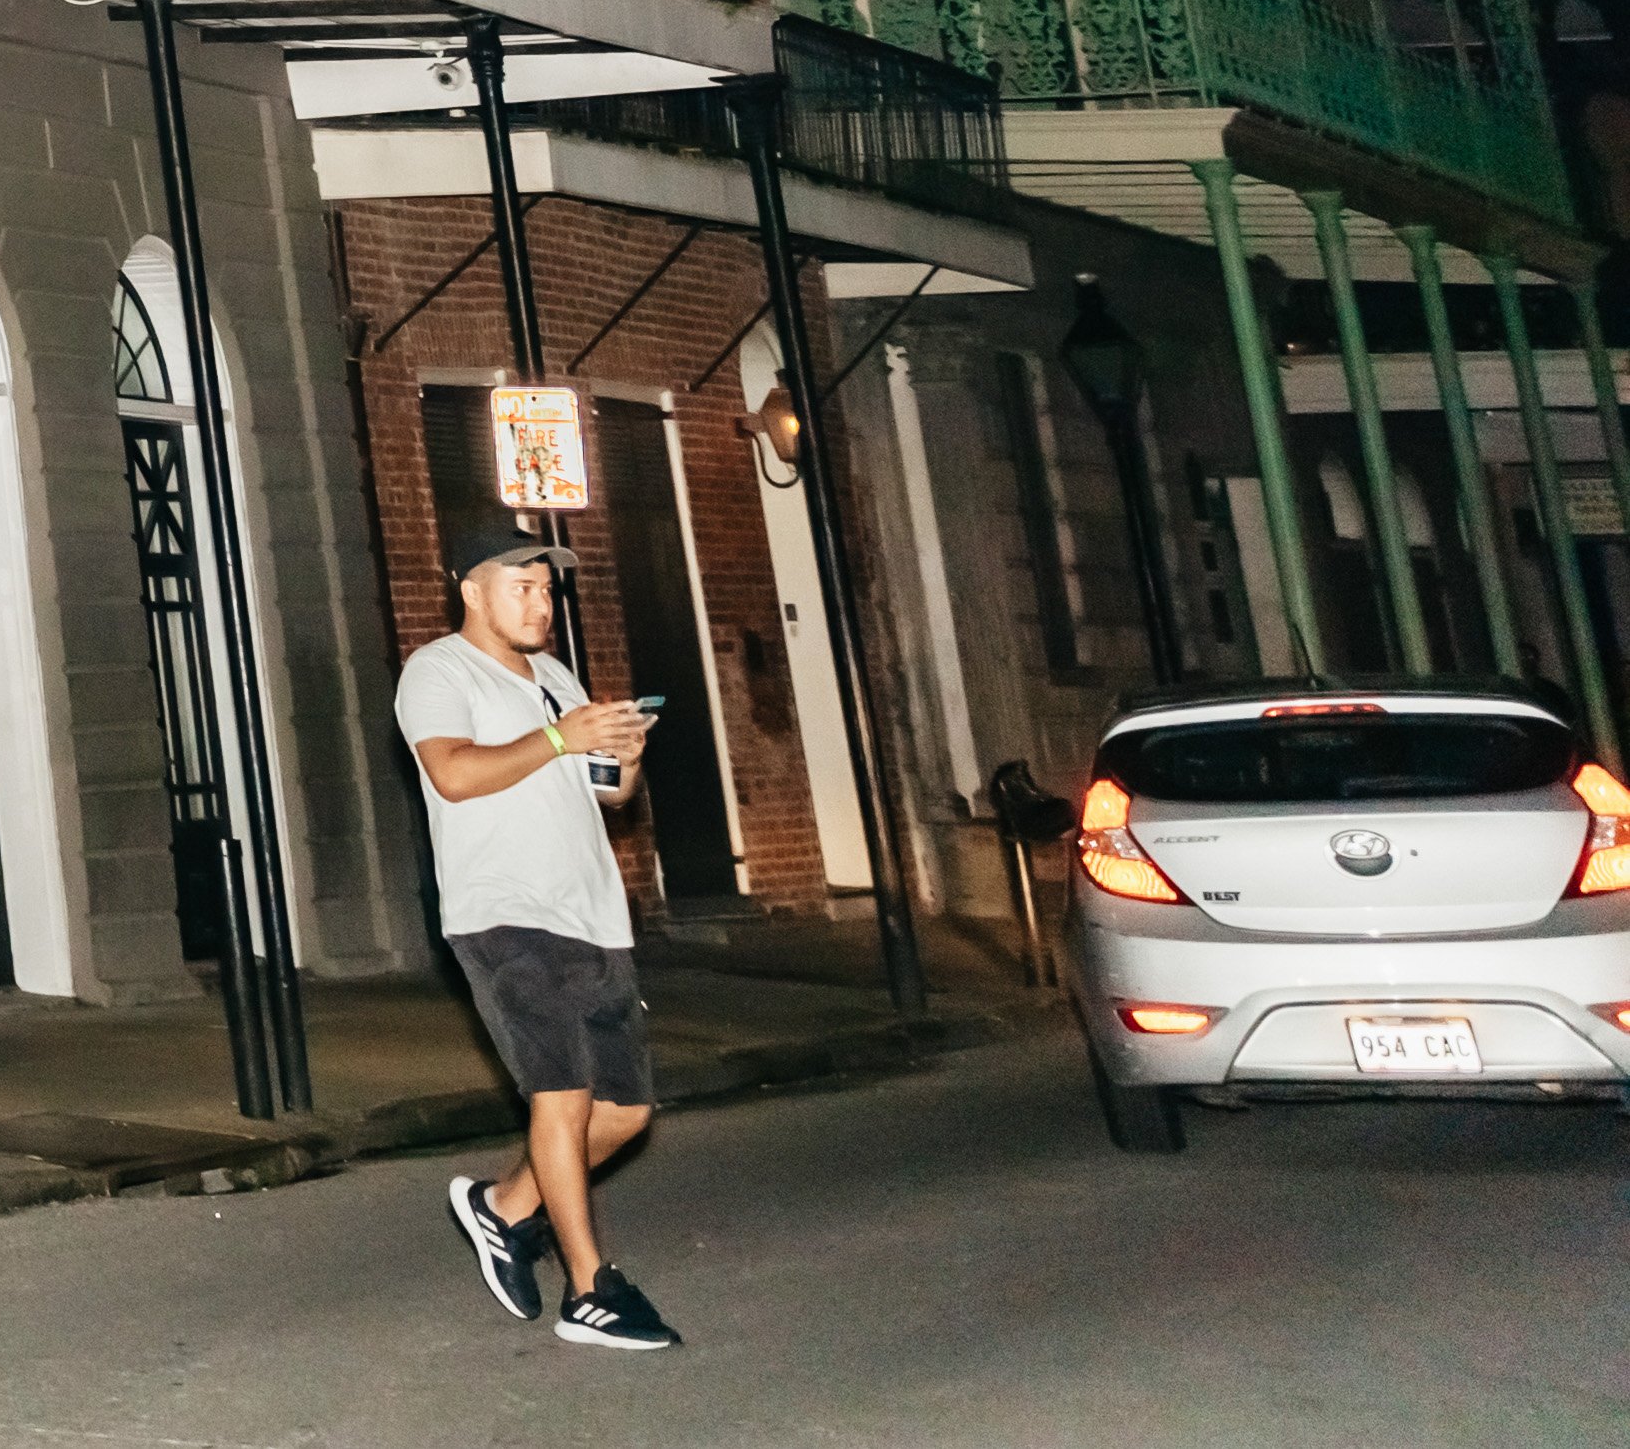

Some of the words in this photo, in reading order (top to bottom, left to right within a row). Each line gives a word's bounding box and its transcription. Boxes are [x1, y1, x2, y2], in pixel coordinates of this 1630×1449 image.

[498, 396, 523, 417] NO
[518, 428, 558, 446] FIRE
[1153, 835, 1220, 844] ACCENT
[1202, 891, 1241, 902] BEST
[1361, 1035, 1406, 1058] 954
[1424, 1035, 1471, 1058] CAC
